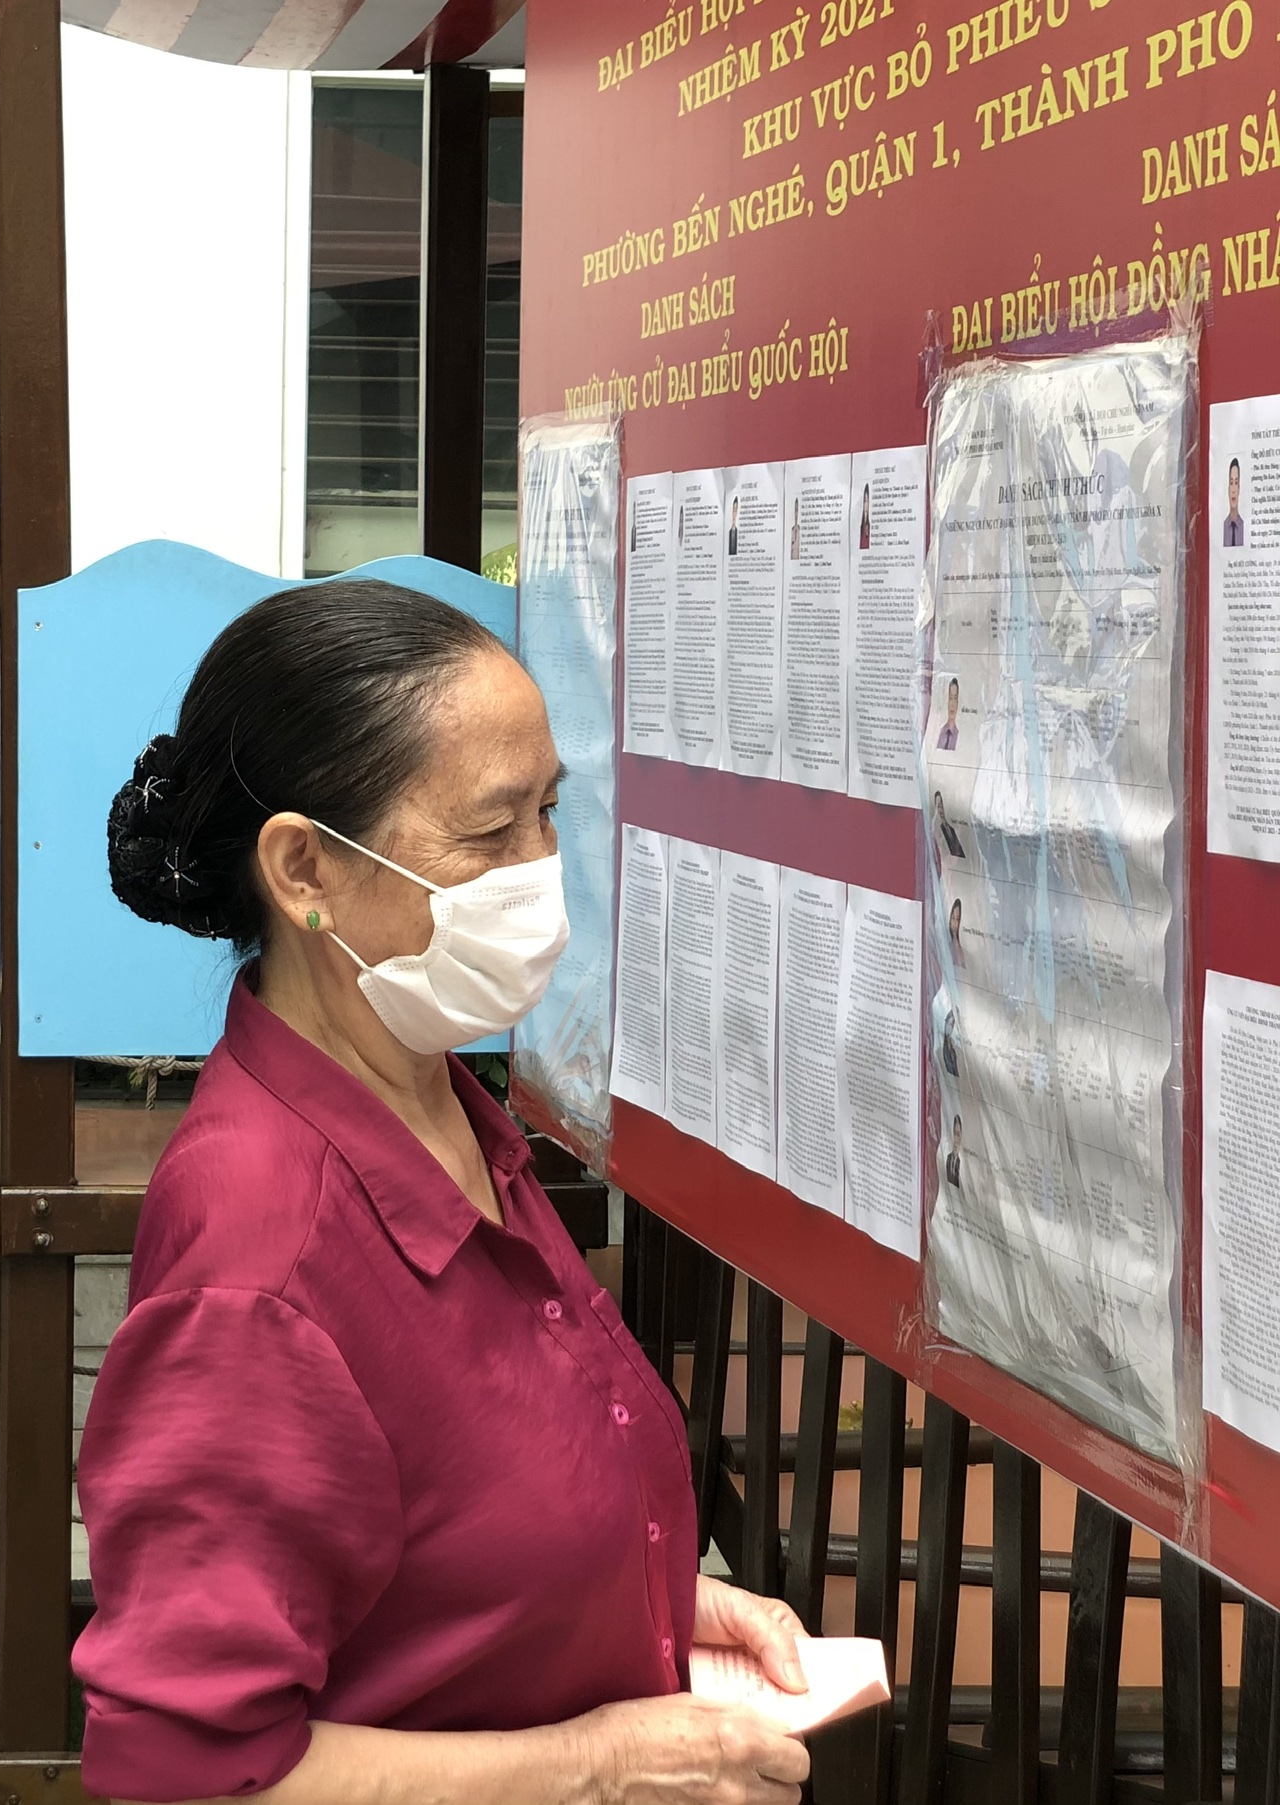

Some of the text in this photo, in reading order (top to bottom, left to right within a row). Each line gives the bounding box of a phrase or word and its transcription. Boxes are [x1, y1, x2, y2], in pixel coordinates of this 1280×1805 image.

[597, 41, 634, 92] ĐẠI
[677, 39, 762, 117] NHIỆM
[769, 6, 811, 73] KỲ
[741, 96, 803, 160] KHU
[810, 64, 876, 131] VỰC
[886, 22, 933, 100] BỎ
[581, 227, 666, 288] PHƯỜNG
[671, 192, 722, 259] BẾN
[727, 162, 815, 238] NGHÉ,
[824, 130, 919, 217] QUẬN
[931, 120, 961, 169] 1,
[975, 45, 1130, 151] THÀNH
[1141, 123, 1229, 205] DANH
[640, 272, 737, 340] DANH SÁCH
[1000, 252, 1062, 345] BIỂU
[1068, 253, 1119, 339] HỘI
[1126, 220, 1212, 318] ĐỒNG
[564, 372, 605, 421] NGƯỜI
[641, 353, 664, 408] CỬ
[667, 360, 697, 410] ĐẠI
[701, 328, 744, 398] BIỂU
[748, 318, 803, 401] QUỐC
[808, 317, 850, 385] HỘI
